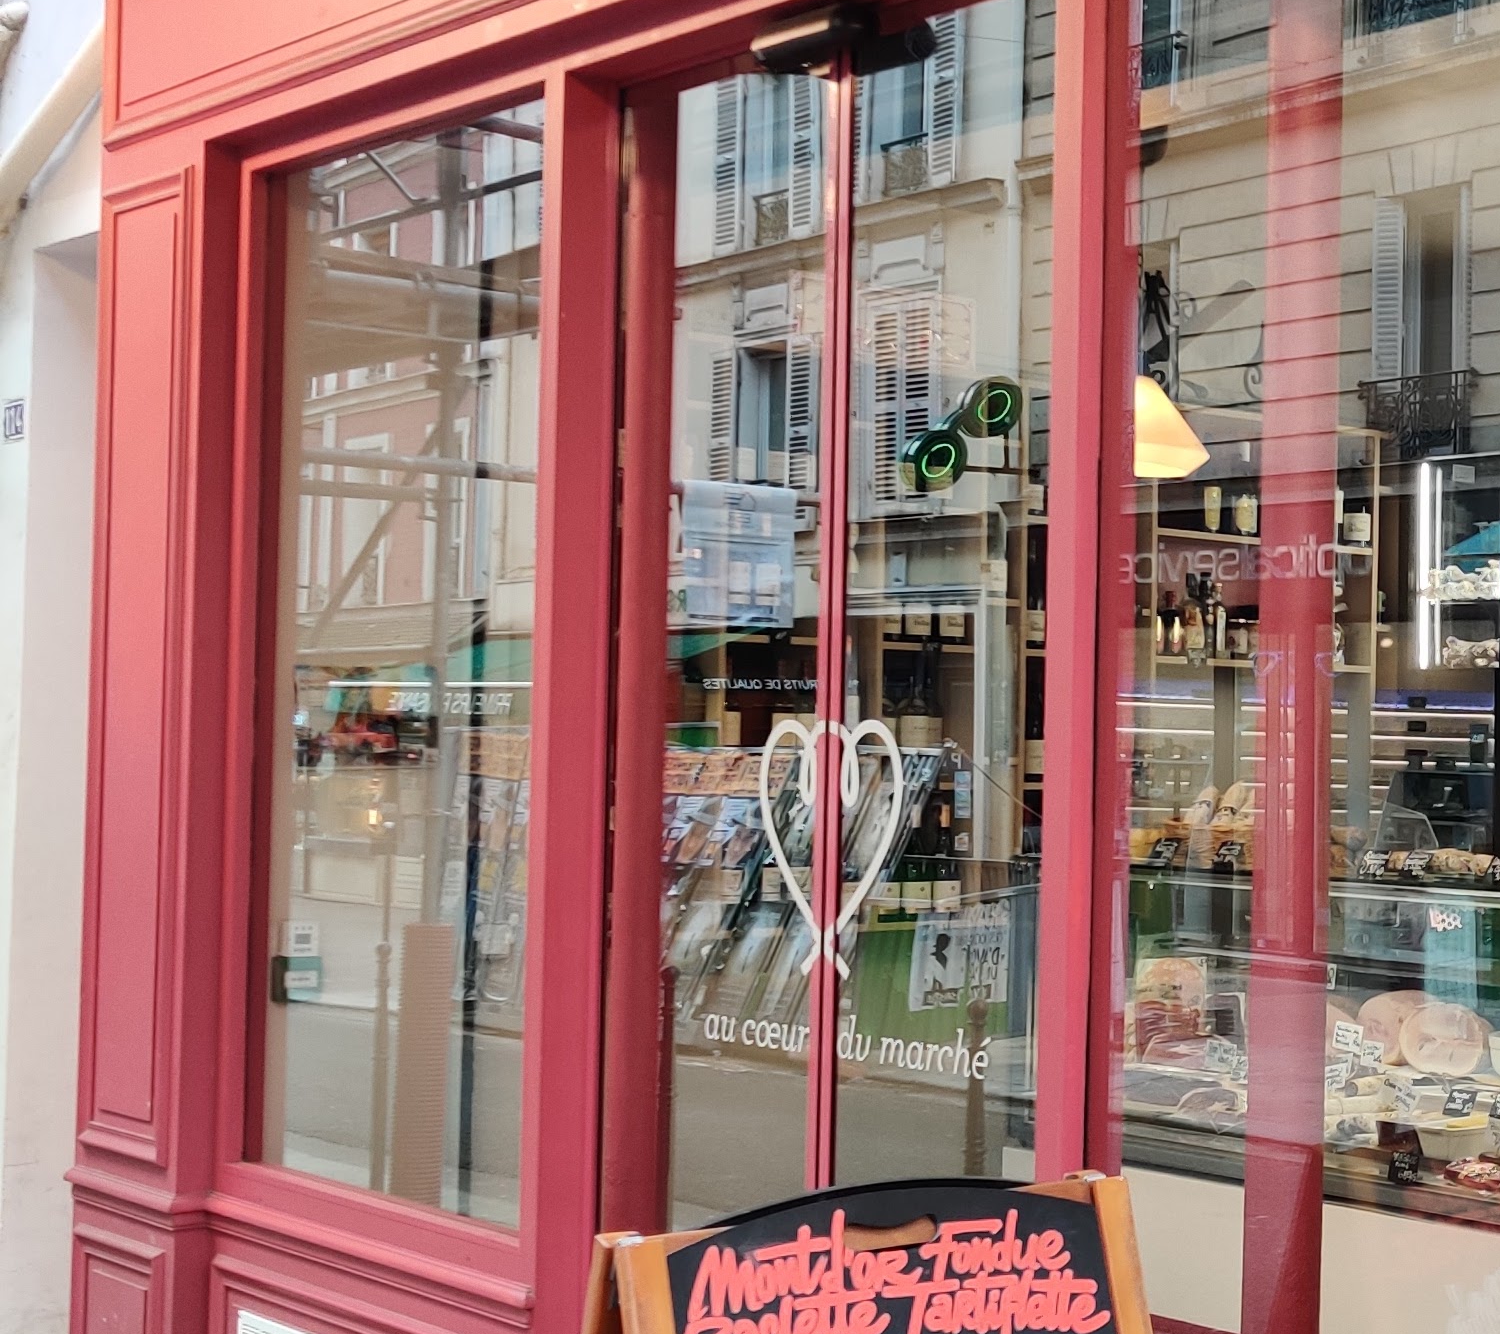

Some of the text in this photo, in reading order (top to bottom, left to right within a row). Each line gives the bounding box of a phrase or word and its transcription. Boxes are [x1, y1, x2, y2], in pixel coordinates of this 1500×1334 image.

[704, 1013, 992, 1080] au cœur du marché
[689, 1224, 831, 1321] Mont
[919, 1209, 1071, 1282] Fondue
